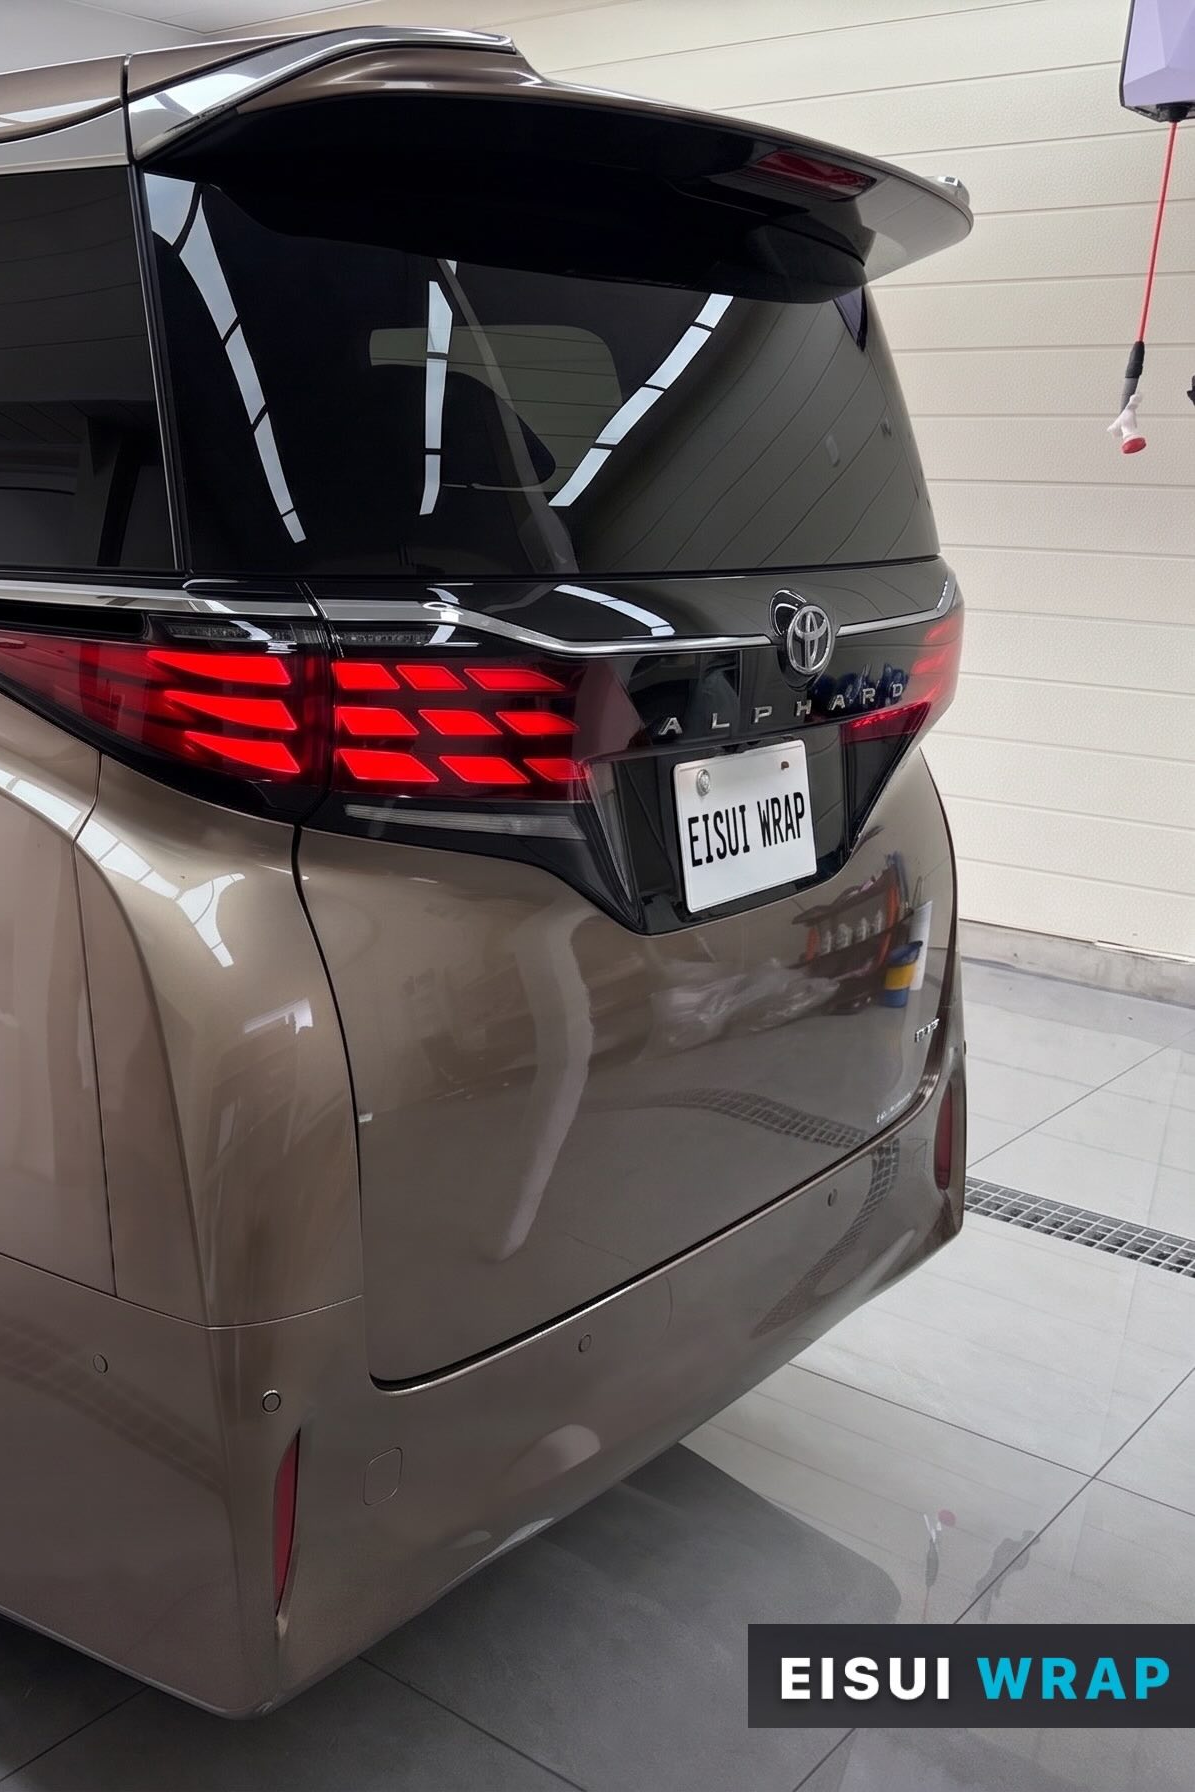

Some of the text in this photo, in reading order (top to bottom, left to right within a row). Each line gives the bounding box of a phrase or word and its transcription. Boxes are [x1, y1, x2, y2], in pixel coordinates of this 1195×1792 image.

[658, 682, 904, 736] ALPHARD
[687, 791, 806, 868] EISUI WRAP
